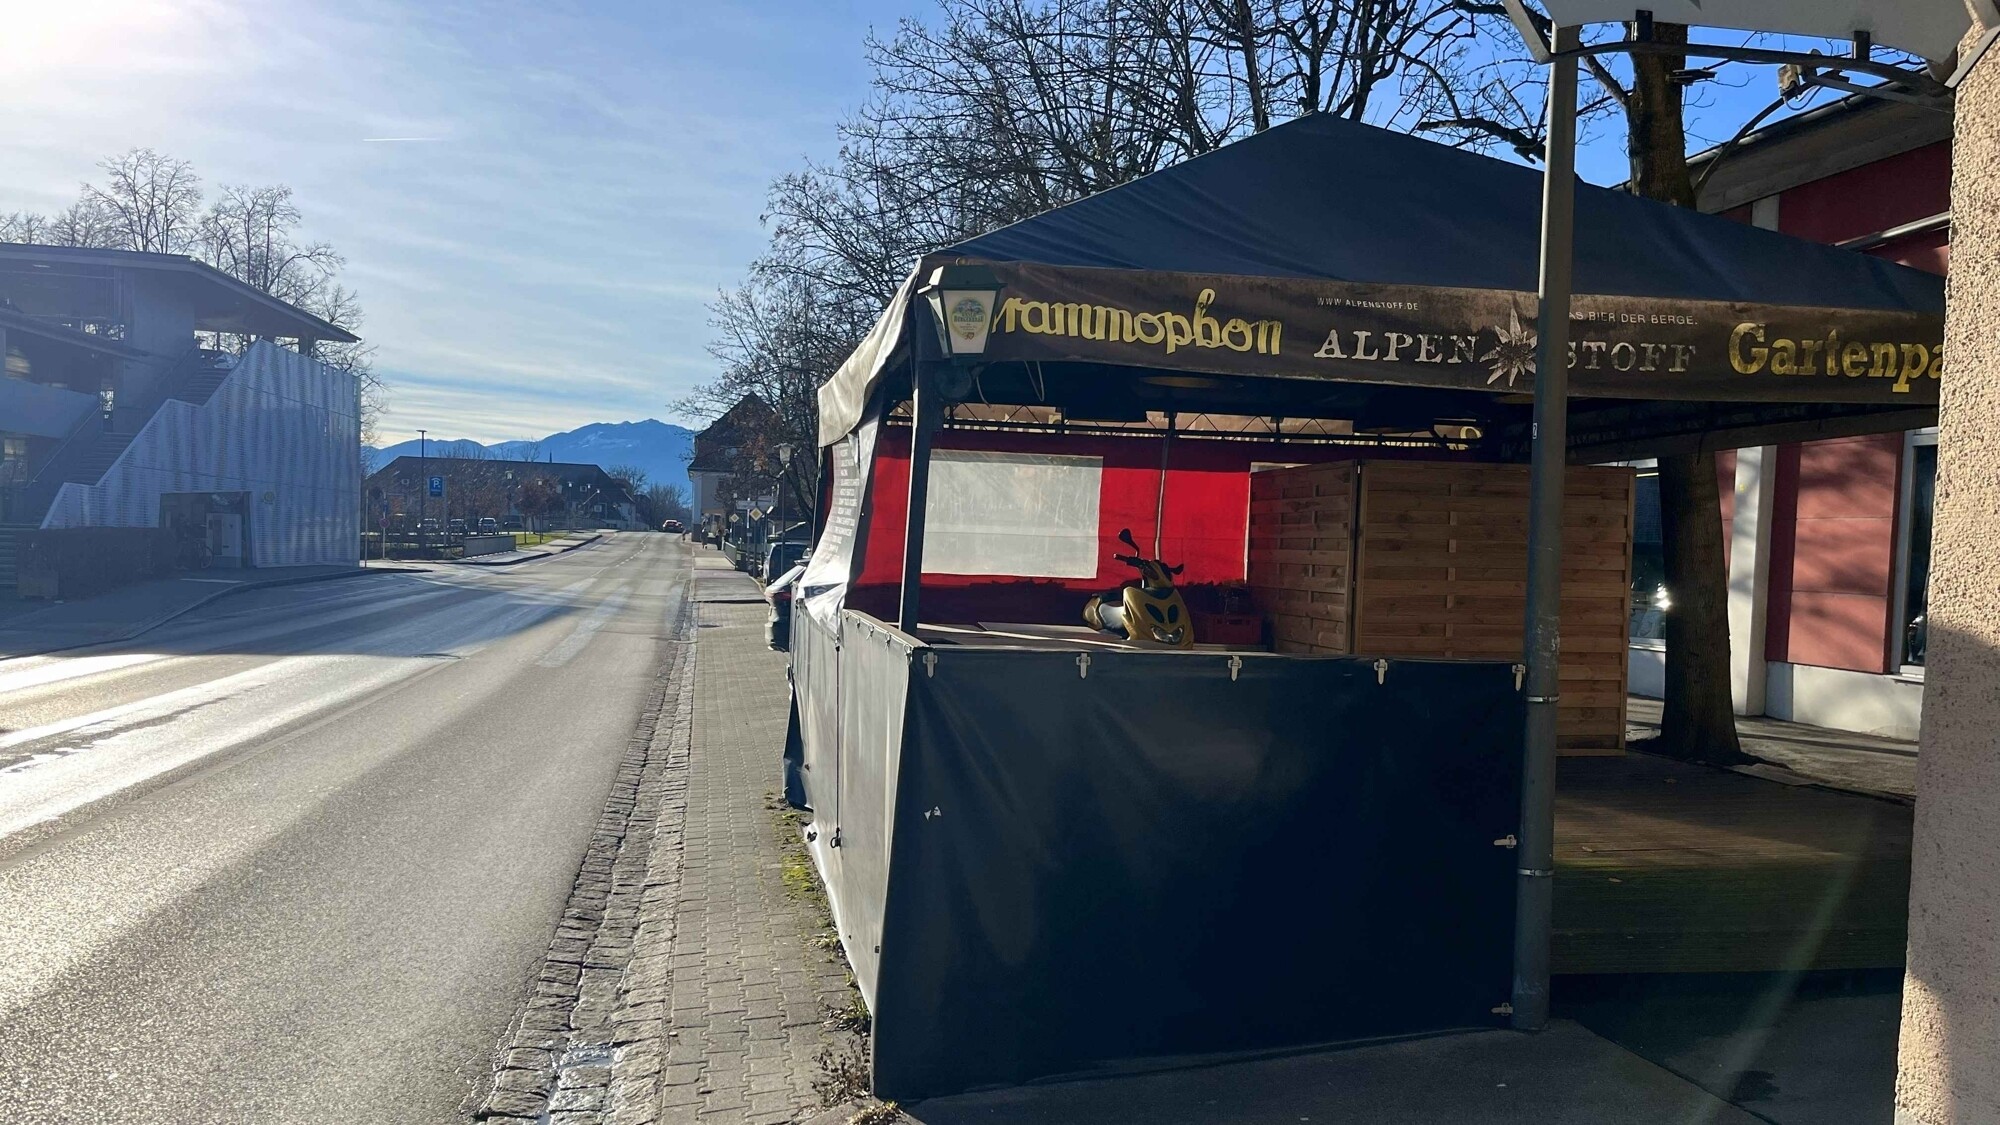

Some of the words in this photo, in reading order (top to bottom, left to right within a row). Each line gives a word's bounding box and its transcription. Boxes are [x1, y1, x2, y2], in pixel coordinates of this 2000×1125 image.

[1317, 298, 1419, 311] WWWALPENSTOFF.DE
[992, 288, 1282, 354] rammophon
[1568, 311, 1583, 320] AS
[1588, 311, 1616, 322] BIER
[1621, 313, 1646, 323] DER
[1651, 314, 1699, 325] BERGE.
[1314, 329, 1478, 363] ALPEN
